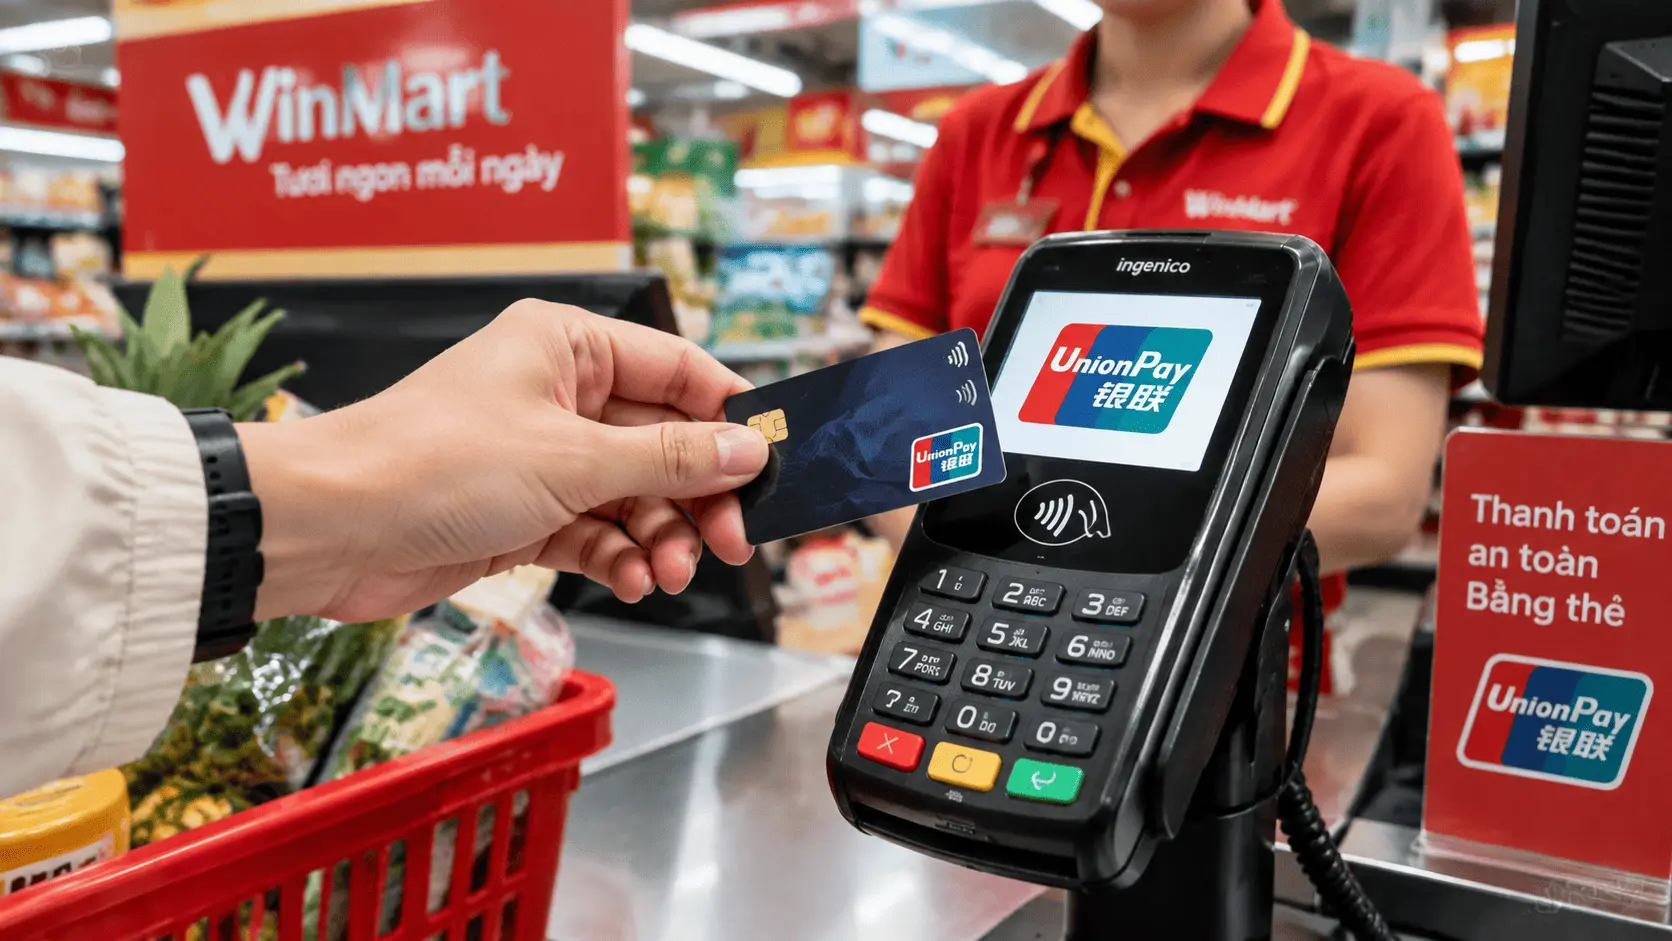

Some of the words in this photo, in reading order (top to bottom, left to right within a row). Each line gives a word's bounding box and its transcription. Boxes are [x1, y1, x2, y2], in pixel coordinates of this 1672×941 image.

[186, 51, 509, 162] WinMart
[335, 162, 410, 202] ngon
[481, 143, 563, 193] ngày
[1116, 257, 1190, 275] ingenico
[1050, 346, 1192, 385] UnionPay
[1092, 381, 1174, 412] 银联
[916, 441, 977, 463] UnionPay
[1470, 493, 1575, 531] Thanh
[1585, 506, 1665, 540] toán
[1468, 544, 1509, 568] an
[1519, 544, 1598, 578] toàn
[937, 568, 948, 589] 1
[1002, 582, 1024, 604] 2
[1082, 593, 1105, 615] 3
[1105, 605, 1129, 616] DEF
[914, 608, 933, 629] 4
[933, 621, 953, 634] GHI
[987, 622, 1009, 645] 5
[1067, 635, 1089, 657] 6
[898, 647, 918, 670] 7
[971, 664, 993, 686] 8
[993, 677, 1016, 691] TUV
[1050, 677, 1072, 700] 9
[956, 705, 977, 728] 0
[1487, 683, 1630, 735] UnionPay
[1536, 725, 1616, 761] 银联
